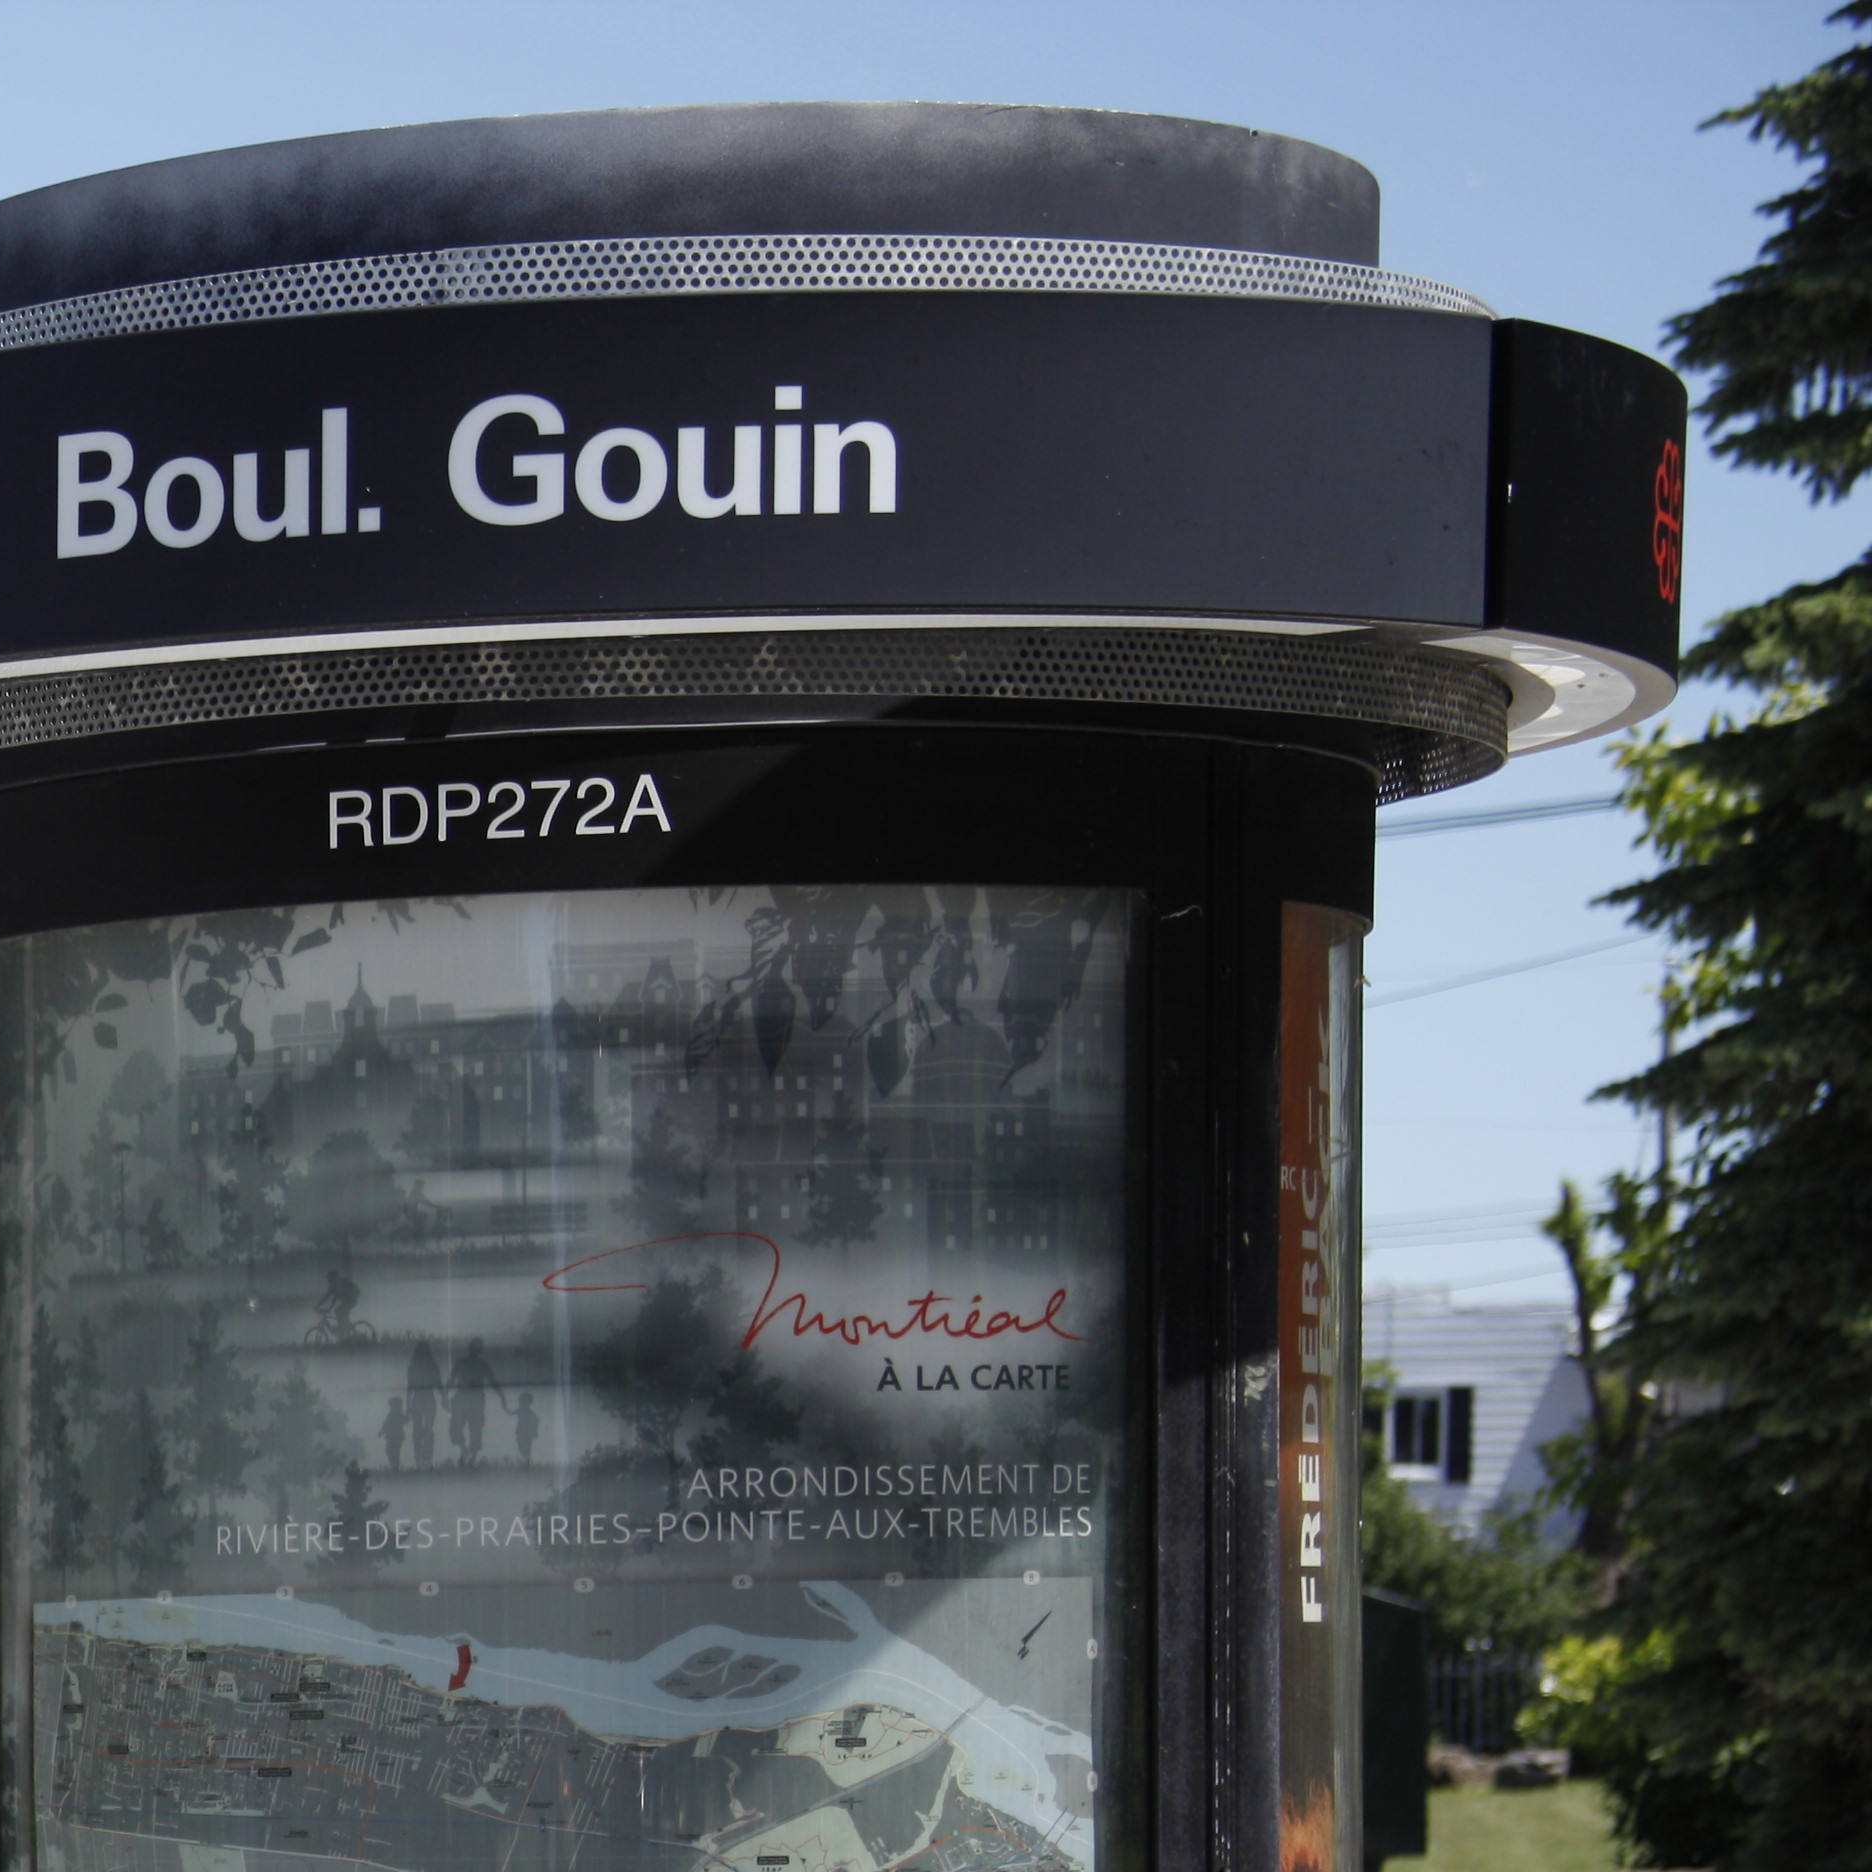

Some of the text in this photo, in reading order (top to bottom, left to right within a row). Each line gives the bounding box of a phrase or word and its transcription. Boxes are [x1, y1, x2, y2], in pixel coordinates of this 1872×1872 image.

[57, 385, 897, 560] Boul. Gouin
[329, 773, 671, 849] RDP272A
[542, 1231, 1099, 1350] Montréal
[876, 1357, 1071, 1392] À LA CARTE
[686, 1462, 1092, 1499] ARRONDISSEMENT DE
